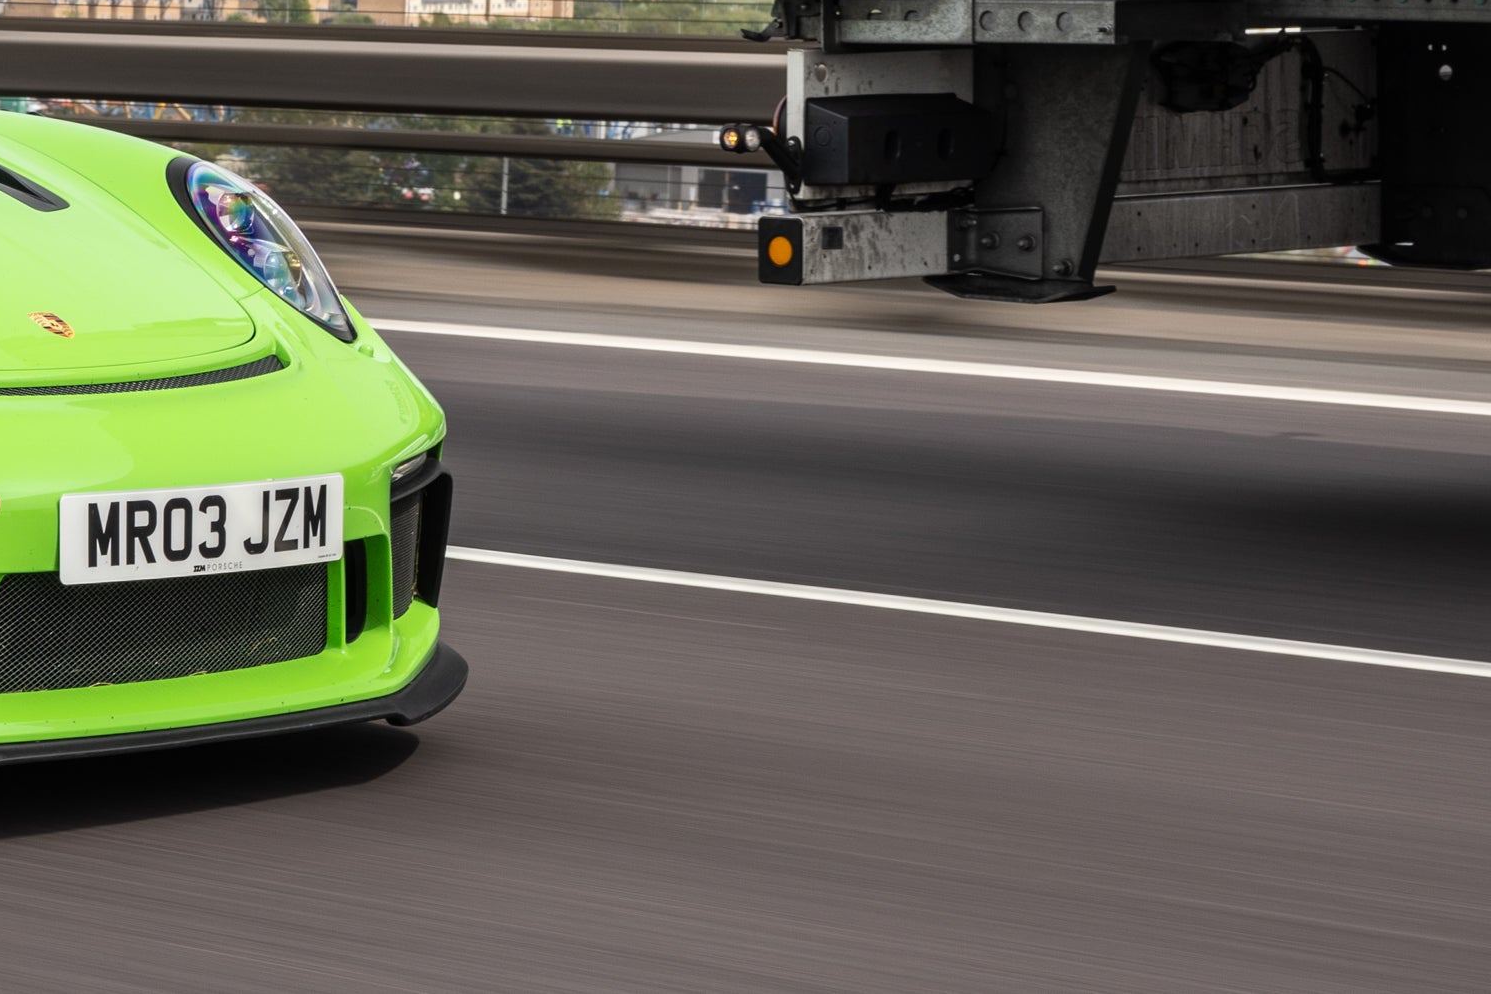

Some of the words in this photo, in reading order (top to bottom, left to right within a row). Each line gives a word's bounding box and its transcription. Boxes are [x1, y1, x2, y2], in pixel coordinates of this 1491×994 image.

[88, 495, 227, 567] MR03
[243, 484, 327, 555] JZM
[207, 561, 243, 571] PORSCHE
